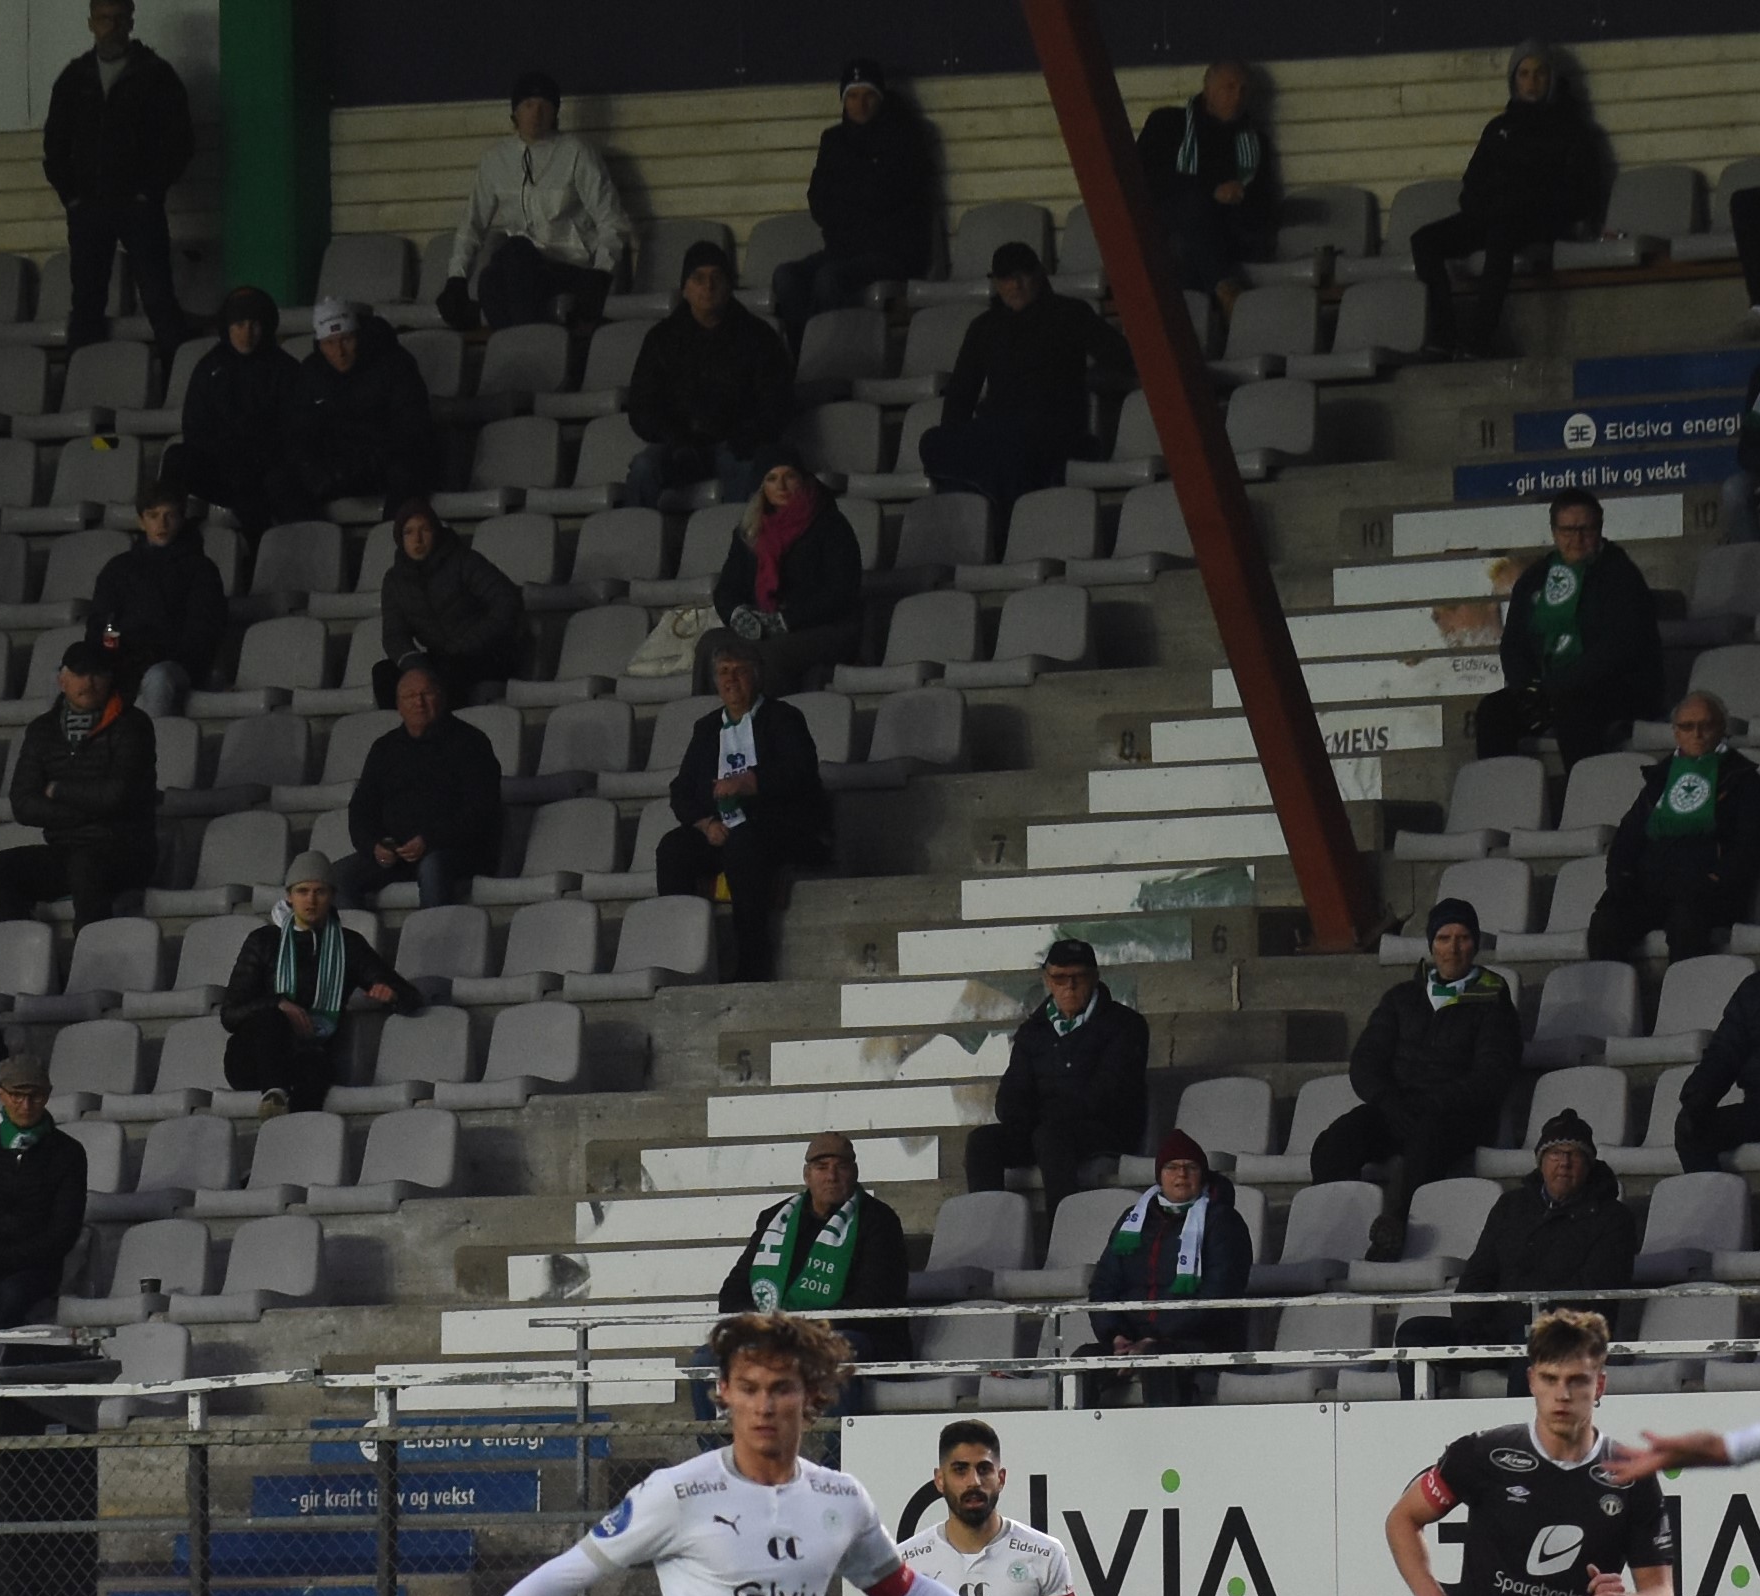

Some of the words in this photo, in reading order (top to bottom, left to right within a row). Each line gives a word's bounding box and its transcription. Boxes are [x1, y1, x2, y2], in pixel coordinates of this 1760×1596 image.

[1605, 420, 1673, 441] Eidsiva
[1683, 415, 1742, 437] energi
[1516, 475, 1536, 497] gir
[1541, 471, 1577, 489] kraft
[1581, 469, 1596, 487] til
[1602, 467, 1619, 485] liv
[1623, 468, 1642, 487] og
[1647, 461, 1687, 482] vekst
[991, 833, 1007, 864] 7
[1212, 924, 1227, 954] 6
[807, 1257, 836, 1274] 1918
[799, 1277, 832, 1296] 2018
[674, 1479, 728, 1500] Eidsiva
[808, 1479, 859, 1497] Eidsiva
[300, 1490, 319, 1512] gir
[325, 1489, 362, 1508] kraft
[410, 1492, 429, 1510] og
[434, 1486, 475, 1506] vekst
[901, 1543, 933, 1562] dsiva
[1008, 1537, 1051, 1558] Eidsiva
